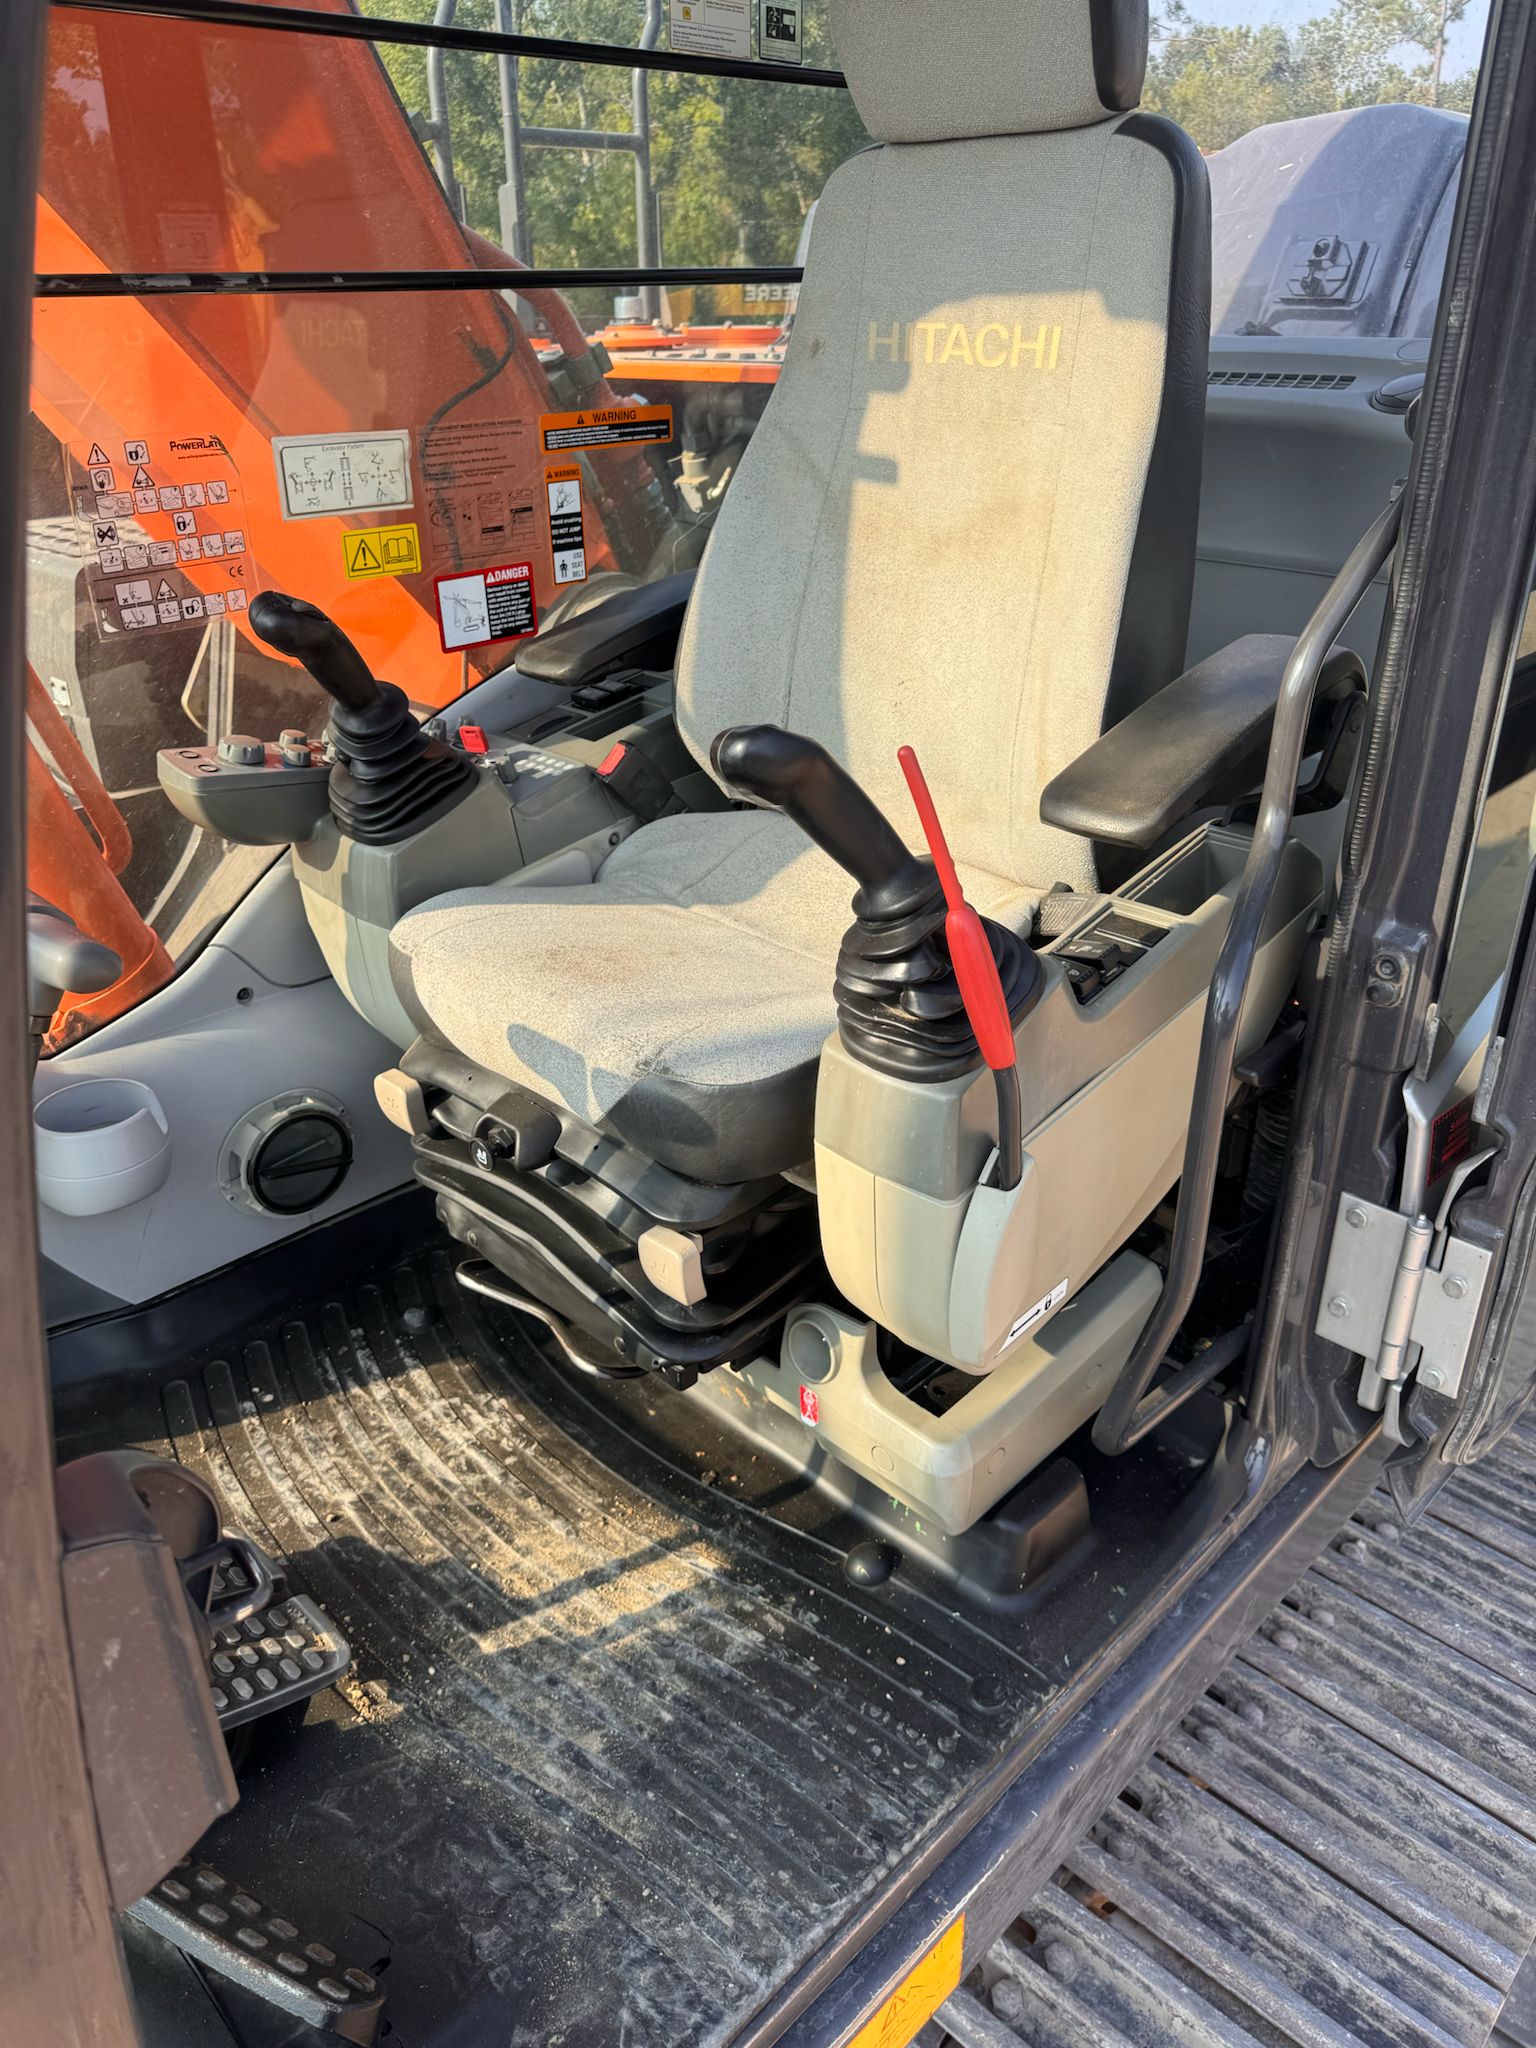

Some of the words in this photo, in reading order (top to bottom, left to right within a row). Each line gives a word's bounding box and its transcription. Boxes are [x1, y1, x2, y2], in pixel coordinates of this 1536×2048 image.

[868, 321, 1062, 369] HITACHI
[593, 410, 637, 423] WARNING
[554, 468, 579, 478] WARNING
[573, 551, 583, 559] USE
[571, 561, 583, 569] SEAT
[229, 565, 244, 578] CE
[495, 565, 529, 582] DANGER
[572, 570, 584, 578] BELT
